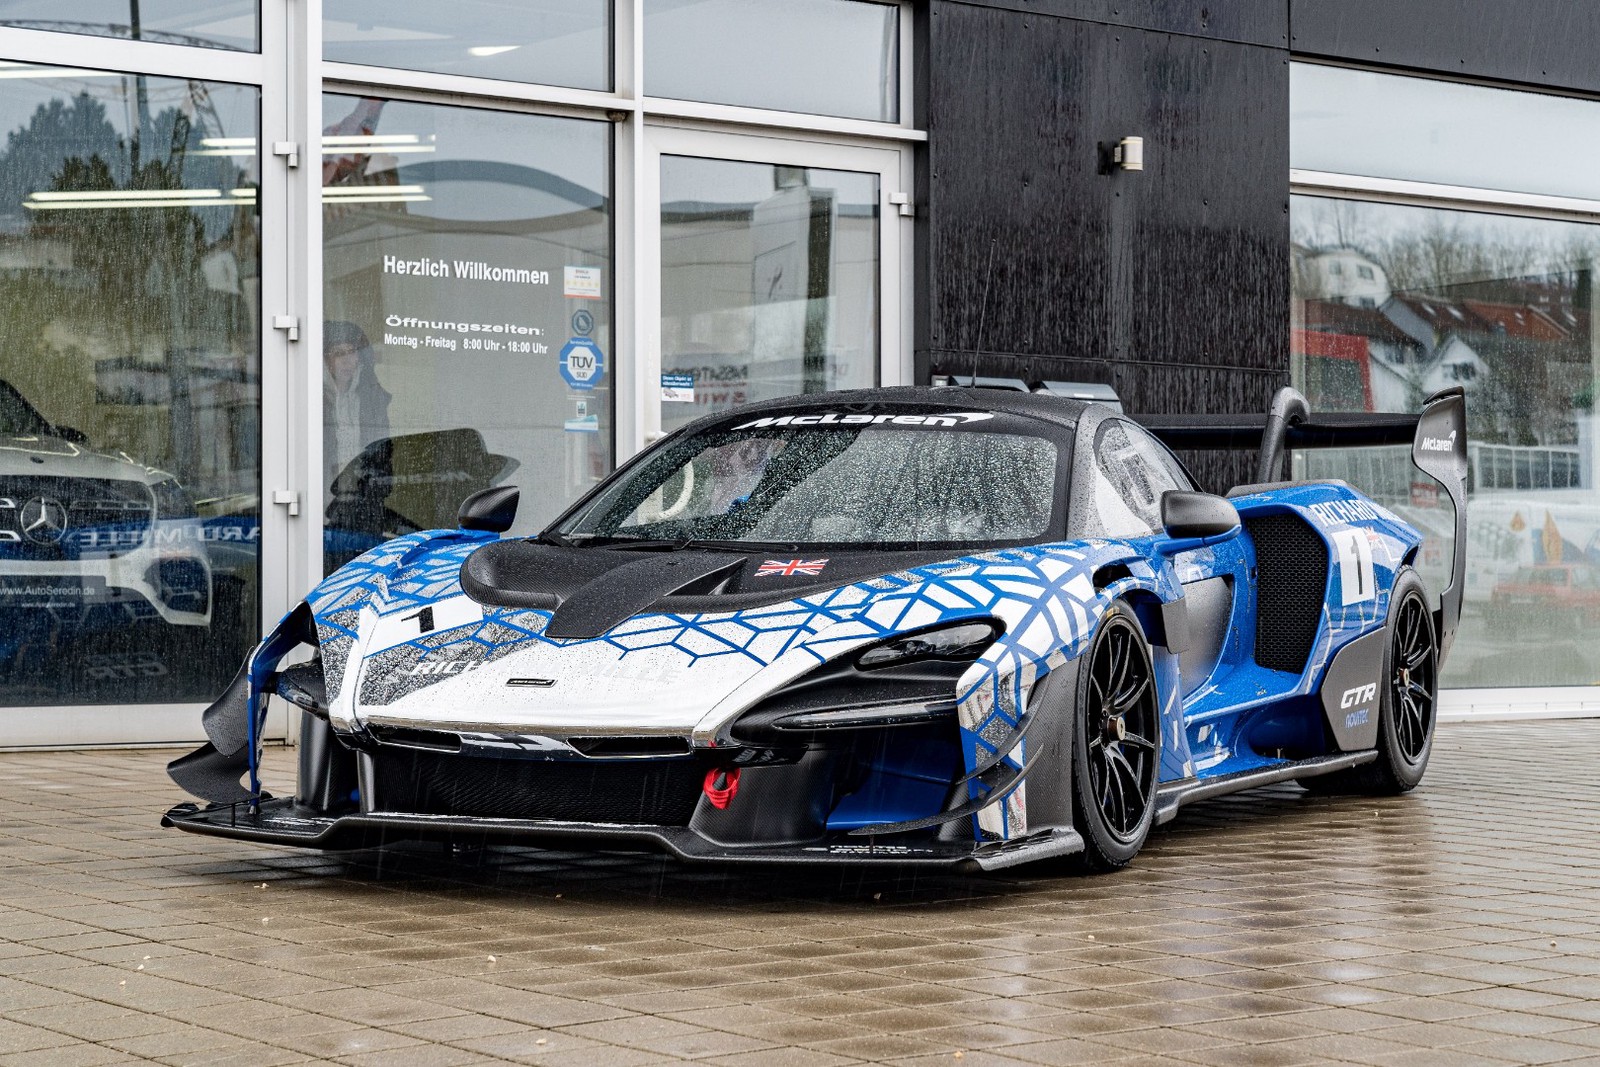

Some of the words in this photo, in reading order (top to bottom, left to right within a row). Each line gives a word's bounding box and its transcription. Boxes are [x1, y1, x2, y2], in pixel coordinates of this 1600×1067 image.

[383, 254, 449, 278] Herzlich
[453, 260, 549, 285] Willkommen
[385, 314, 545, 336] Öffnungszeiten:
[384, 333, 418, 349] Montag
[425, 335, 457, 351] Freitag
[463, 338, 482, 350] 8:00
[483, 339, 500, 351] Uhr
[507, 341, 531, 353] 18:00
[532, 343, 548, 354] Uhr
[730, 413, 960, 428] McLaren
[1421, 434, 1454, 451] McLaren
[1308, 500, 1379, 526] RICHARD
[1350, 534, 1364, 596] 1
[400, 605, 435, 634] 1
[1340, 682, 1377, 709] GTR
